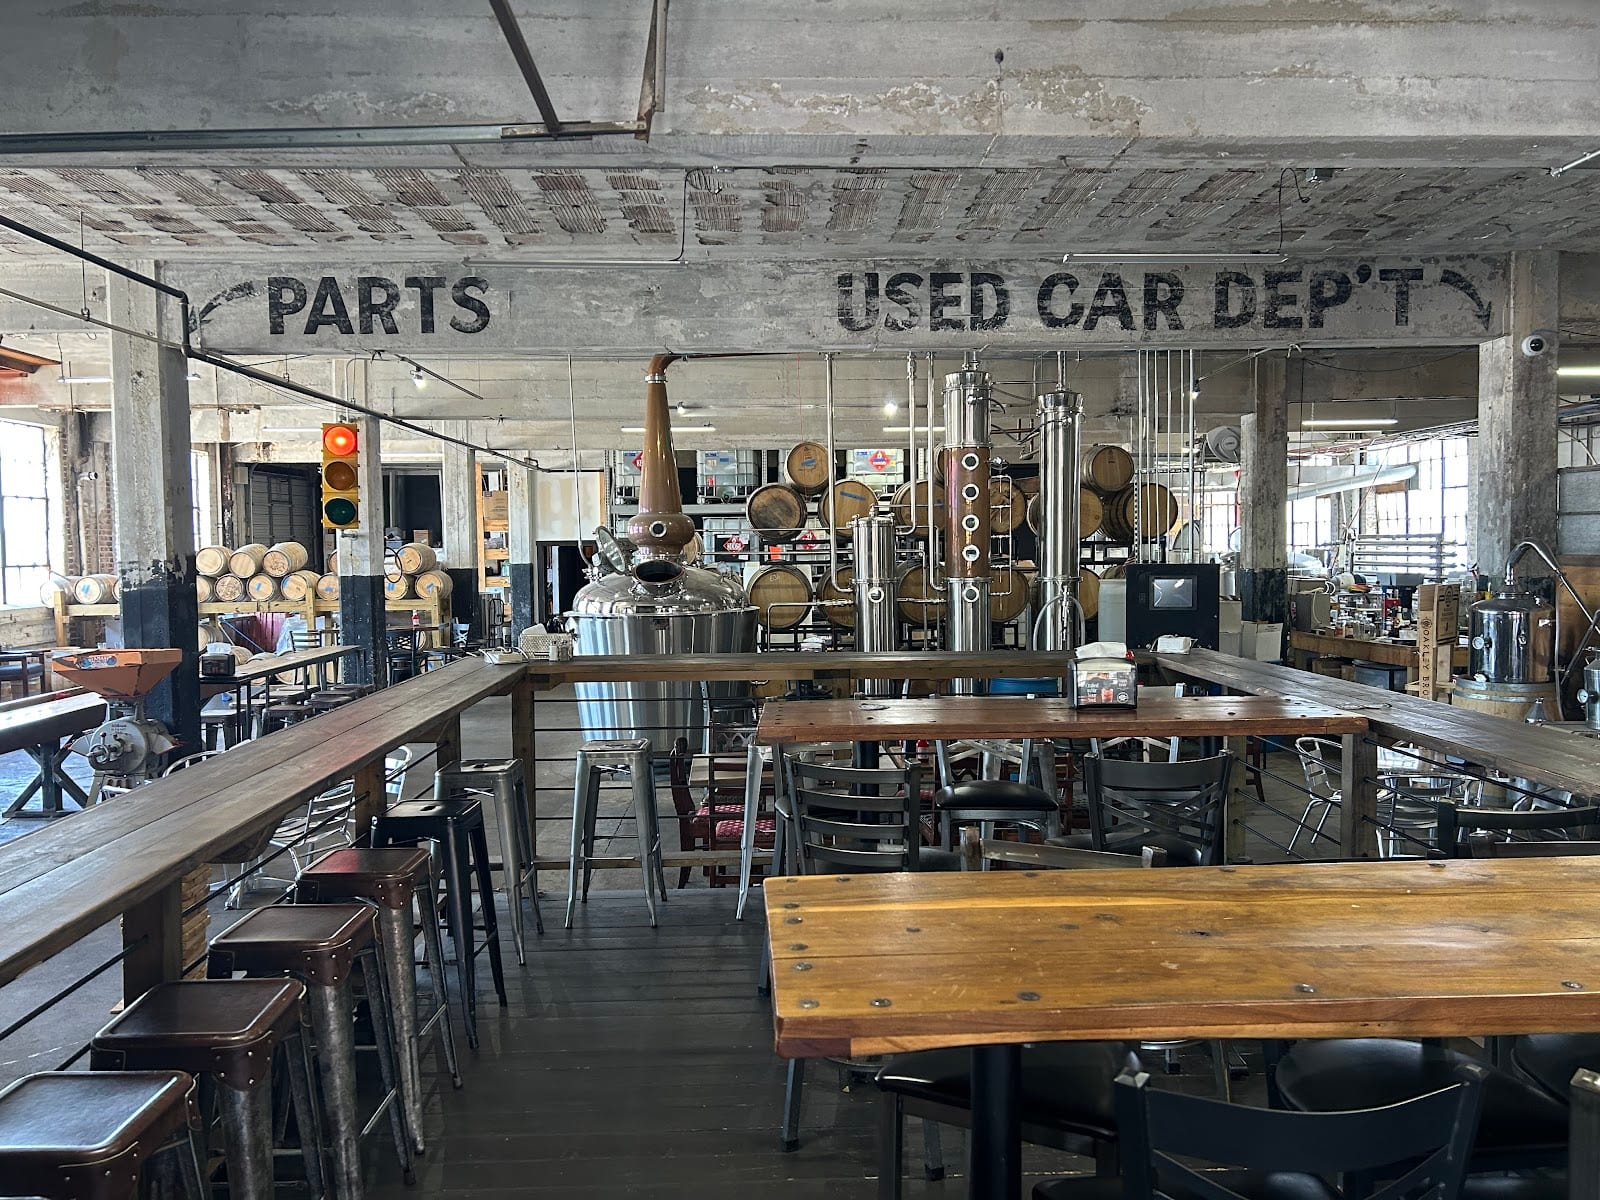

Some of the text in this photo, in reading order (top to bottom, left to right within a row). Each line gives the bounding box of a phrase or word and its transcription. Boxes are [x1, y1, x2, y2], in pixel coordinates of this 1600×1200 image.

[267, 276, 491, 335] PARTS
[837, 264, 1424, 332] USED CAR DEP'T
[1422, 629, 1430, 670] OAKLEY
